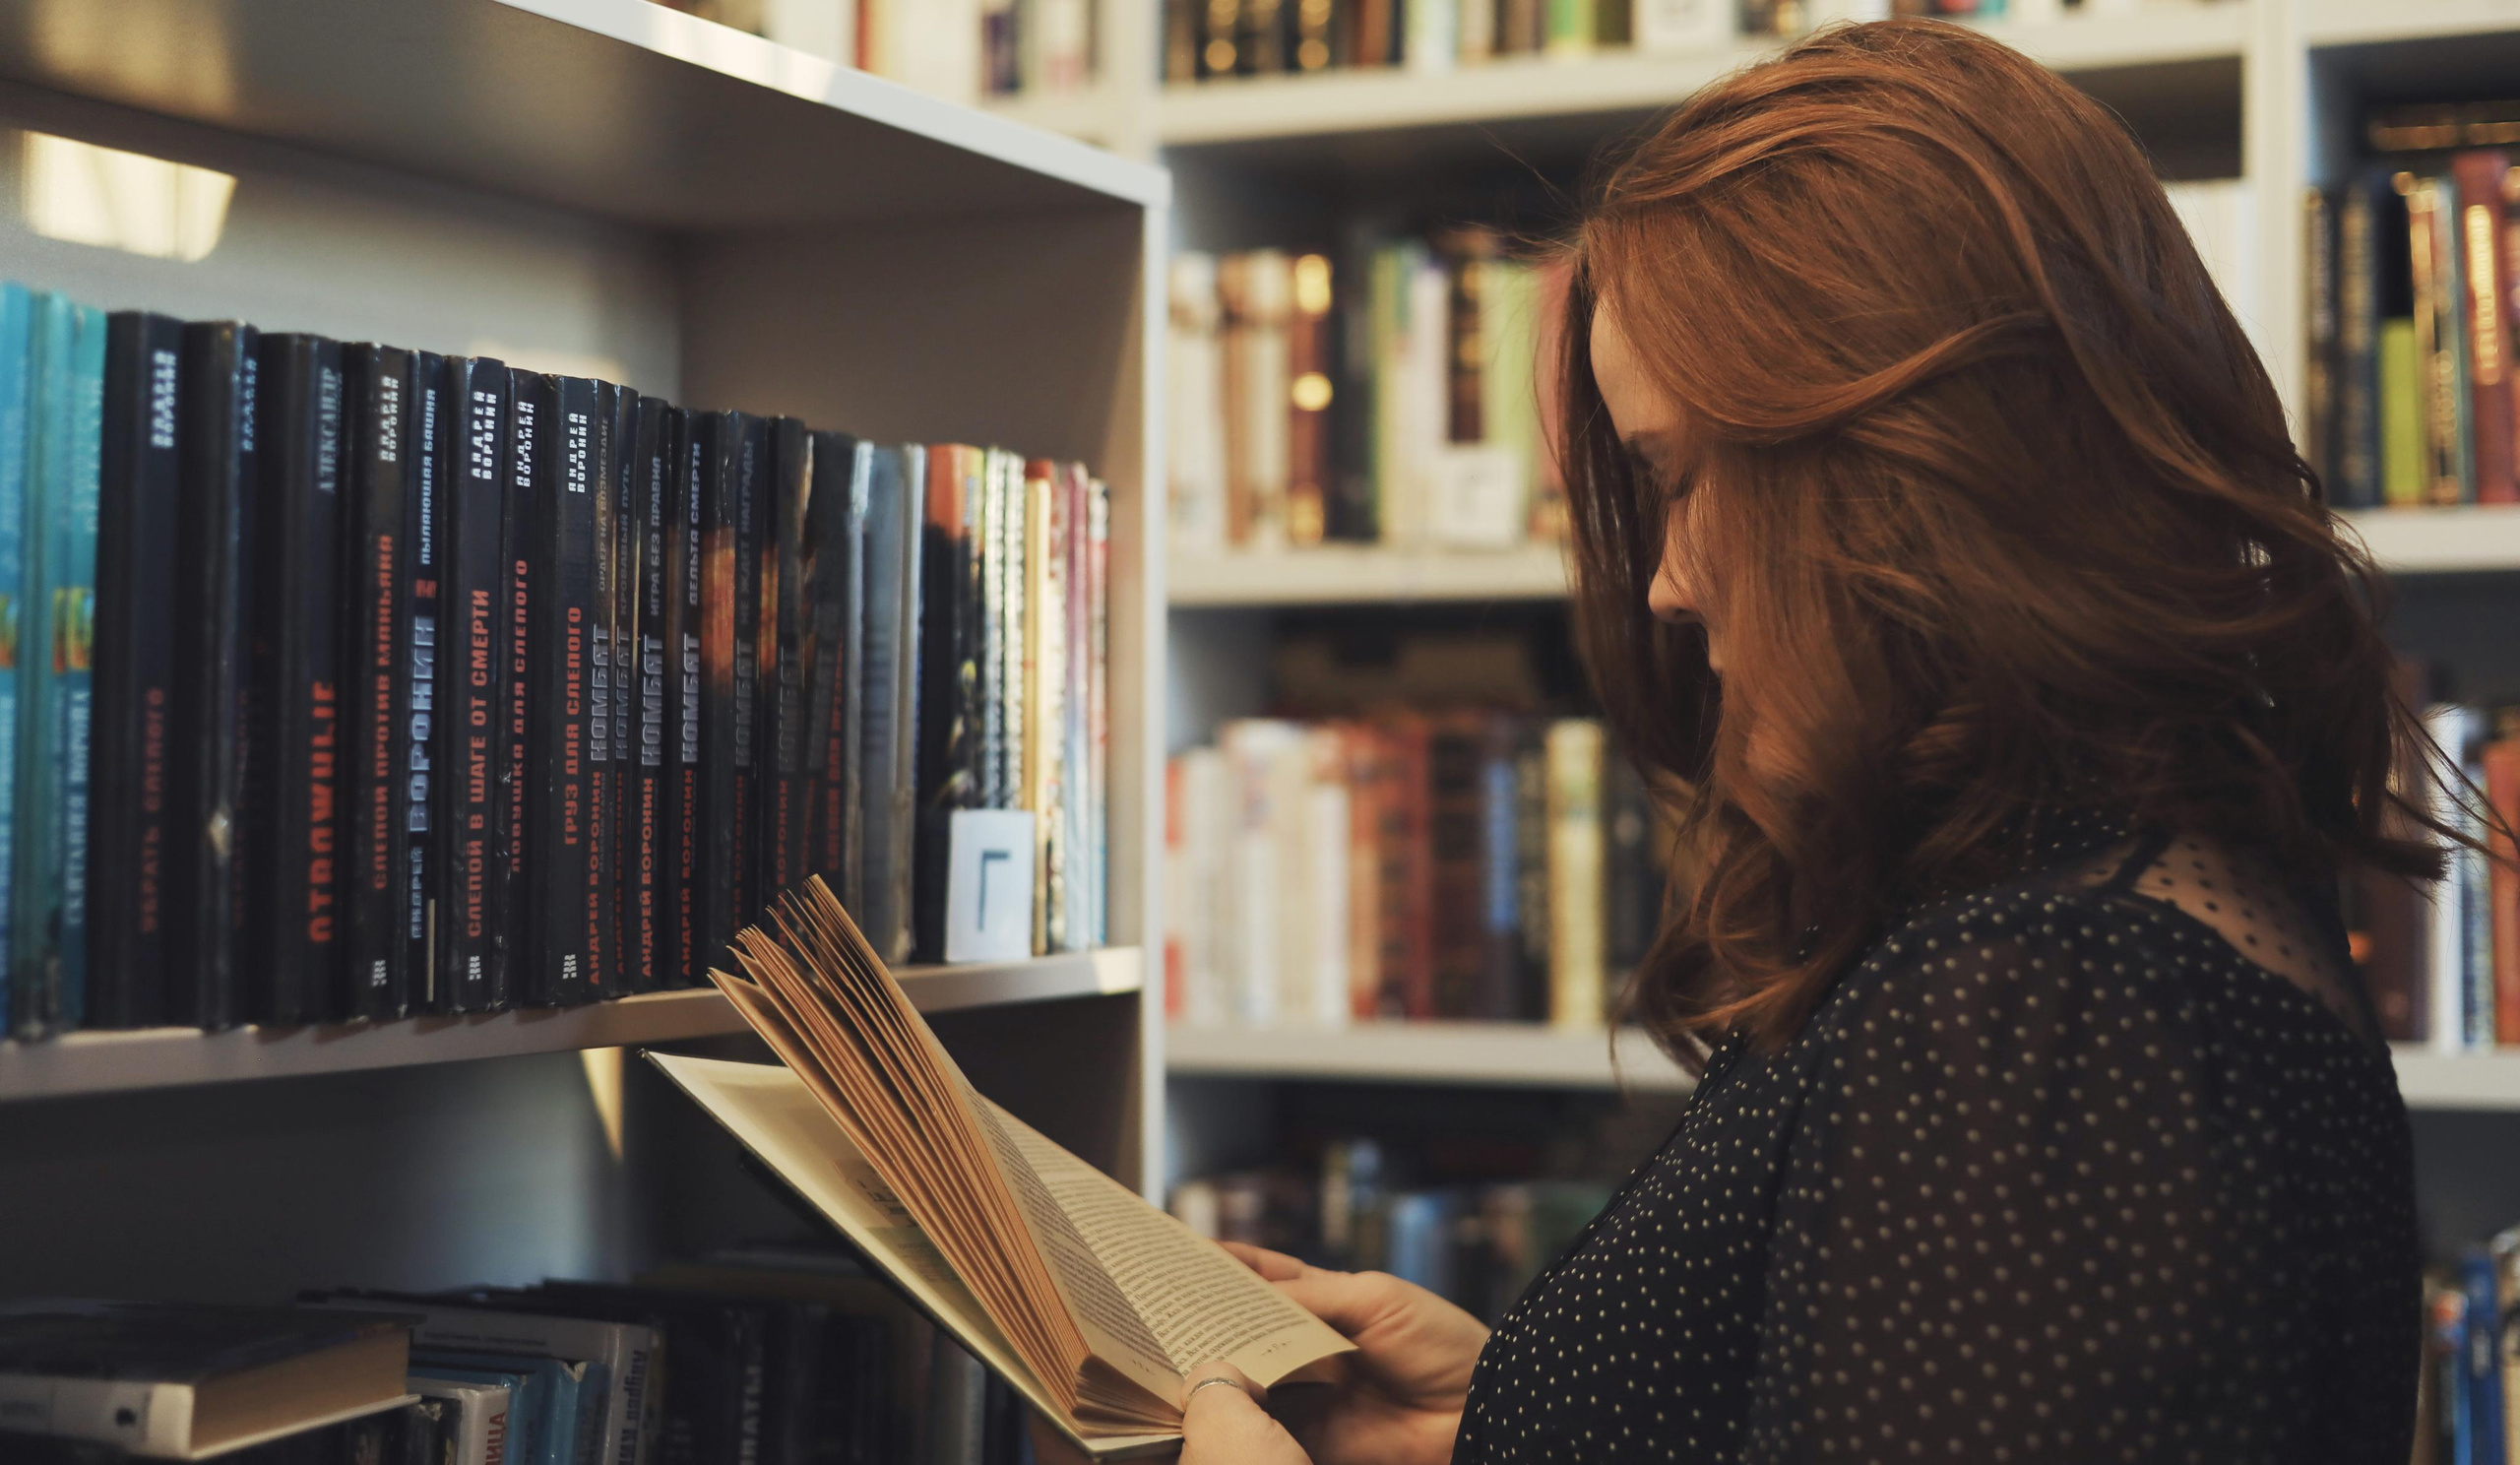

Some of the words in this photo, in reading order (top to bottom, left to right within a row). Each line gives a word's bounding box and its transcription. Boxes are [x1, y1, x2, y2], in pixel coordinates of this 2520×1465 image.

[378, 375, 391, 461] АНДРЕЙ
[388, 378, 400, 463] ВОРОНИН
[421, 389, 436, 453] БАШНЯ
[472, 391, 485, 478] АНДРЕЙ
[481, 392, 497, 480] ВОРОНИН
[515, 401, 529, 486] АНДРЕЙ
[523, 403, 535, 488] ВОРОНИН
[567, 412, 579, 492] АНДРЕЙ
[576, 414, 589, 494] ВОРОНИН
[598, 415, 611, 508] ВОЗМЕЗДИЕ
[420, 455, 434, 565] ПЫЛАЮЩАЯ
[598, 516, 607, 538] НА
[620, 463, 631, 509] ПУТЬ
[651, 456, 663, 528] ПРАВИЛ
[689, 441, 702, 525] СМЕРТИ
[598, 541, 608, 593] ОРДЕР
[617, 513, 629, 616] КРОВАВЫЙ
[649, 572, 662, 616] ИГРА
[650, 533, 662, 568] БЕЗ
[688, 530, 700, 607] ДЕЛЬТА
[375, 534, 394, 668] МАНЬЯКА
[471, 589, 491, 688] СМЕРТИ
[513, 558, 530, 673] СЛЕПОГО
[564, 605, 585, 717] СЛЕПОГО
[373, 674, 391, 778] ПРОТИВ
[408, 615, 436, 833] ВОРОНИН
[471, 696, 489, 729] ОТ
[510, 680, 528, 735] ДЛЯ
[563, 723, 582, 777] ДЛЯ
[468, 734, 488, 803] ШАГЕ
[509, 742, 526, 874] ЛОВУШКА
[370, 786, 389, 890] СЛЕПОЙ
[468, 812, 484, 831] В
[562, 783, 582, 847] ГРУЗ
[589, 770, 602, 887] ВОРОНИН
[614, 771, 625, 882] ВОРОНИН
[640, 778, 655, 885] ВОРОНИН
[681, 768, 695, 880] ВОРОНИН
[732, 774, 745, 883] ВОРОНИН
[777, 779, 789, 885] ВОРОНИН
[410, 845, 424, 939] АНДРЕЙ
[467, 840, 483, 938] СЛЕПОЙ
[613, 886, 625, 976] АНДРЕЙ
[680, 887, 694, 978] АНДРЕЙ
[978, 850, 1011, 931] Г
[587, 891, 602, 986] АНДРЕЙ
[640, 890, 654, 978] АНДРЕЙ
